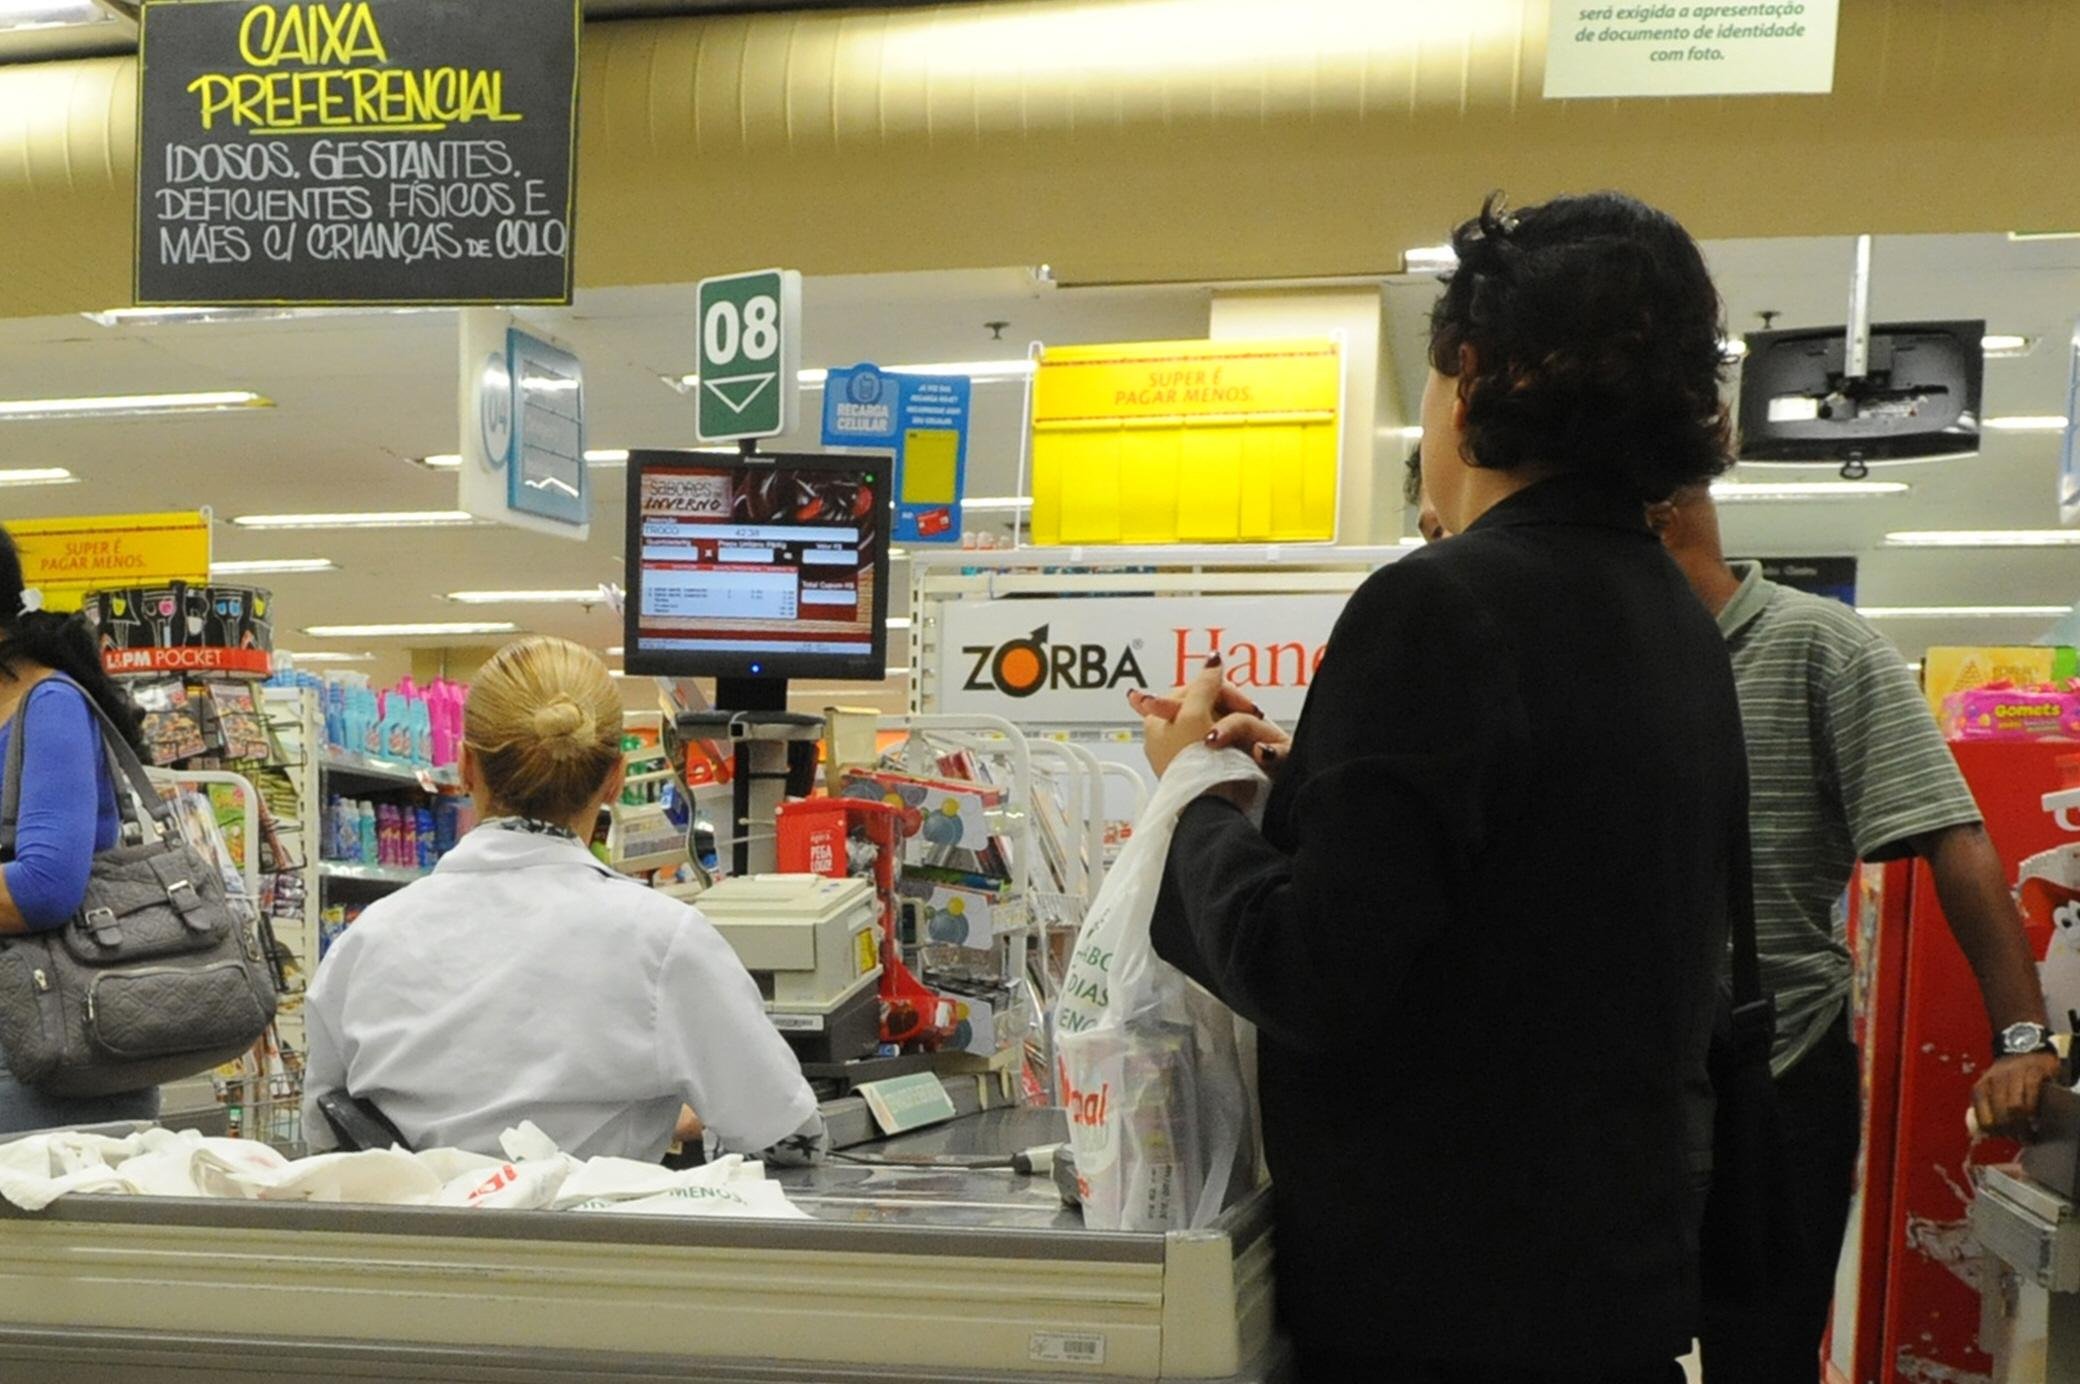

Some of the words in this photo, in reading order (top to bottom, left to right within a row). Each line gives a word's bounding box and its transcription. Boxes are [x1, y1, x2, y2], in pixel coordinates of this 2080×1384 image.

[1579, 5, 1613, 20] será
[1616, 5, 1676, 22] exigida
[1679, 7, 1690, 18] a
[1693, 1, 1805, 21] apresentação
[239, 2, 388, 67] CAIXA
[1575, 27, 1595, 42] de
[1598, 26, 1690, 42] documento
[1693, 24, 1714, 39] de
[1717, 22, 1805, 39] identidade
[1650, 50, 1684, 62] com
[1688, 46, 1725, 62] foto.
[187, 67, 523, 130] PREFERENCIAL
[155, 186, 373, 221] DEFICIENTES
[524, 180, 551, 216] E
[306, 221, 463, 265] CRIANÇAS
[465, 238, 493, 258] DE
[496, 219, 568, 261] COLO
[704, 295, 778, 365] 08
[1149, 371, 1206, 388] SUPER
[1115, 388, 1177, 405] PAGAR
[645, 497, 722, 512] INVERNO
[66, 541, 109, 556] SUPER
[40, 556, 87, 571] PAGAR
[154, 649, 223, 667] POCKET
[962, 638, 1148, 698] ZORBA
